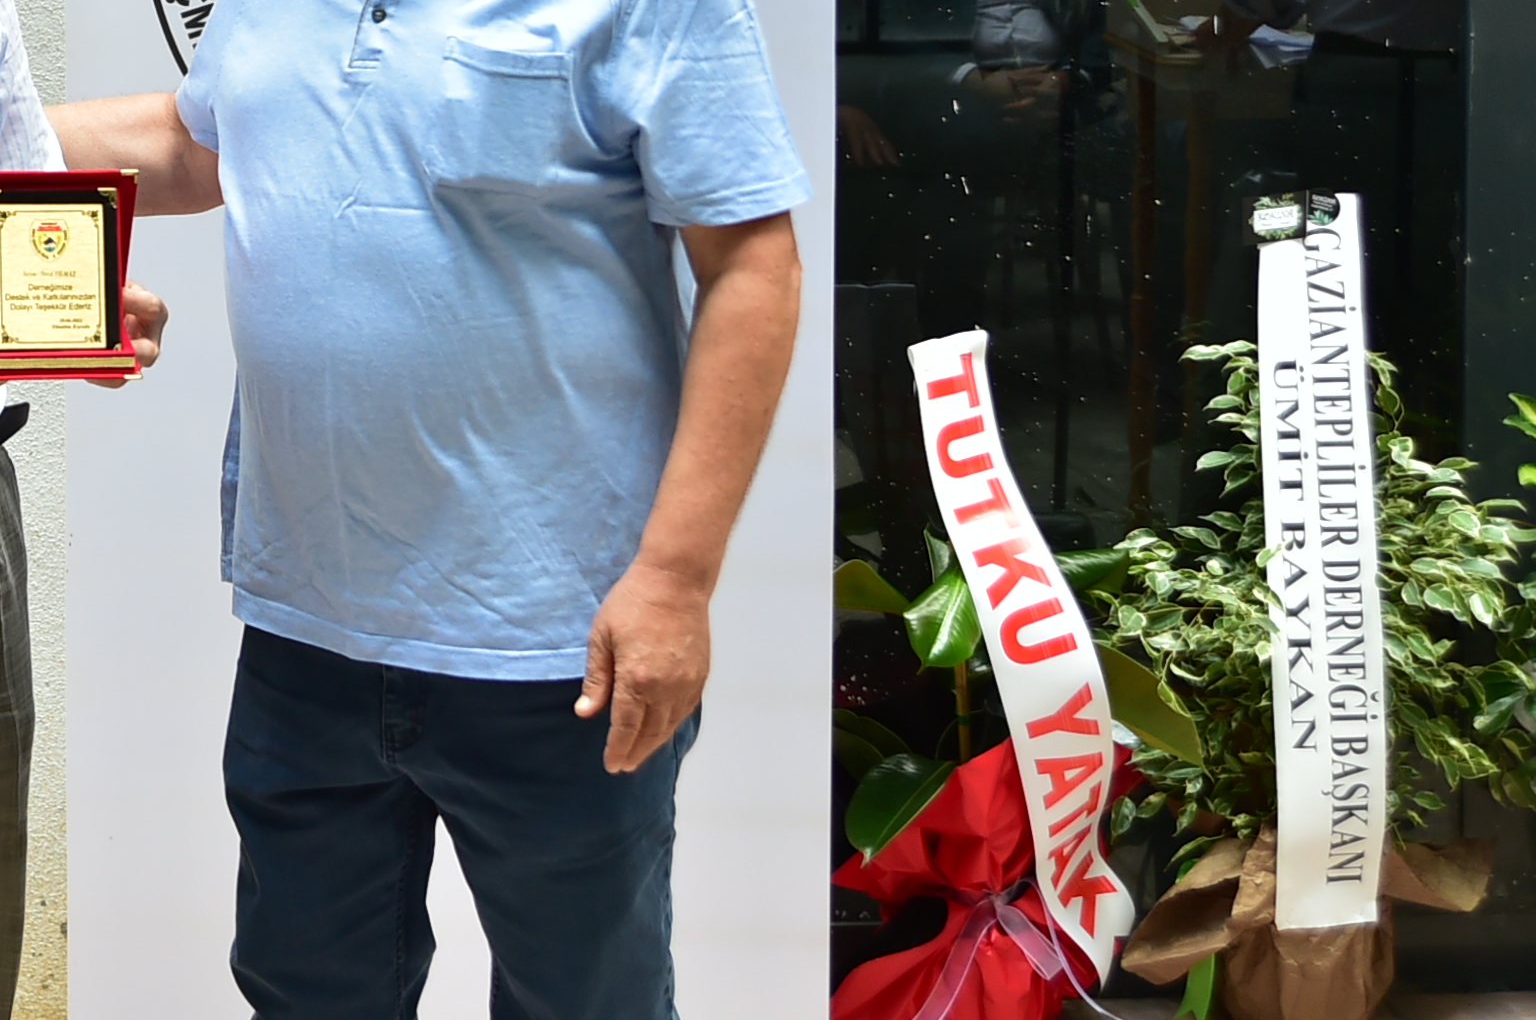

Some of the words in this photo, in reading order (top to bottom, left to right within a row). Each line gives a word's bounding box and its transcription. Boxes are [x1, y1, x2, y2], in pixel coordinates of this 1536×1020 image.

[1273, 357, 1309, 502] ÜMİT
[1302, 228, 1367, 548] GAZİANTEPLİLER
[926, 351, 1079, 666] TUTKU
[1025, 681, 1119, 940] YATAK
[1281, 517, 1318, 753] BAYKAN
[1321, 558, 1379, 725] DERNEĞİ
[1321, 734, 1371, 885] BAŞKANI
